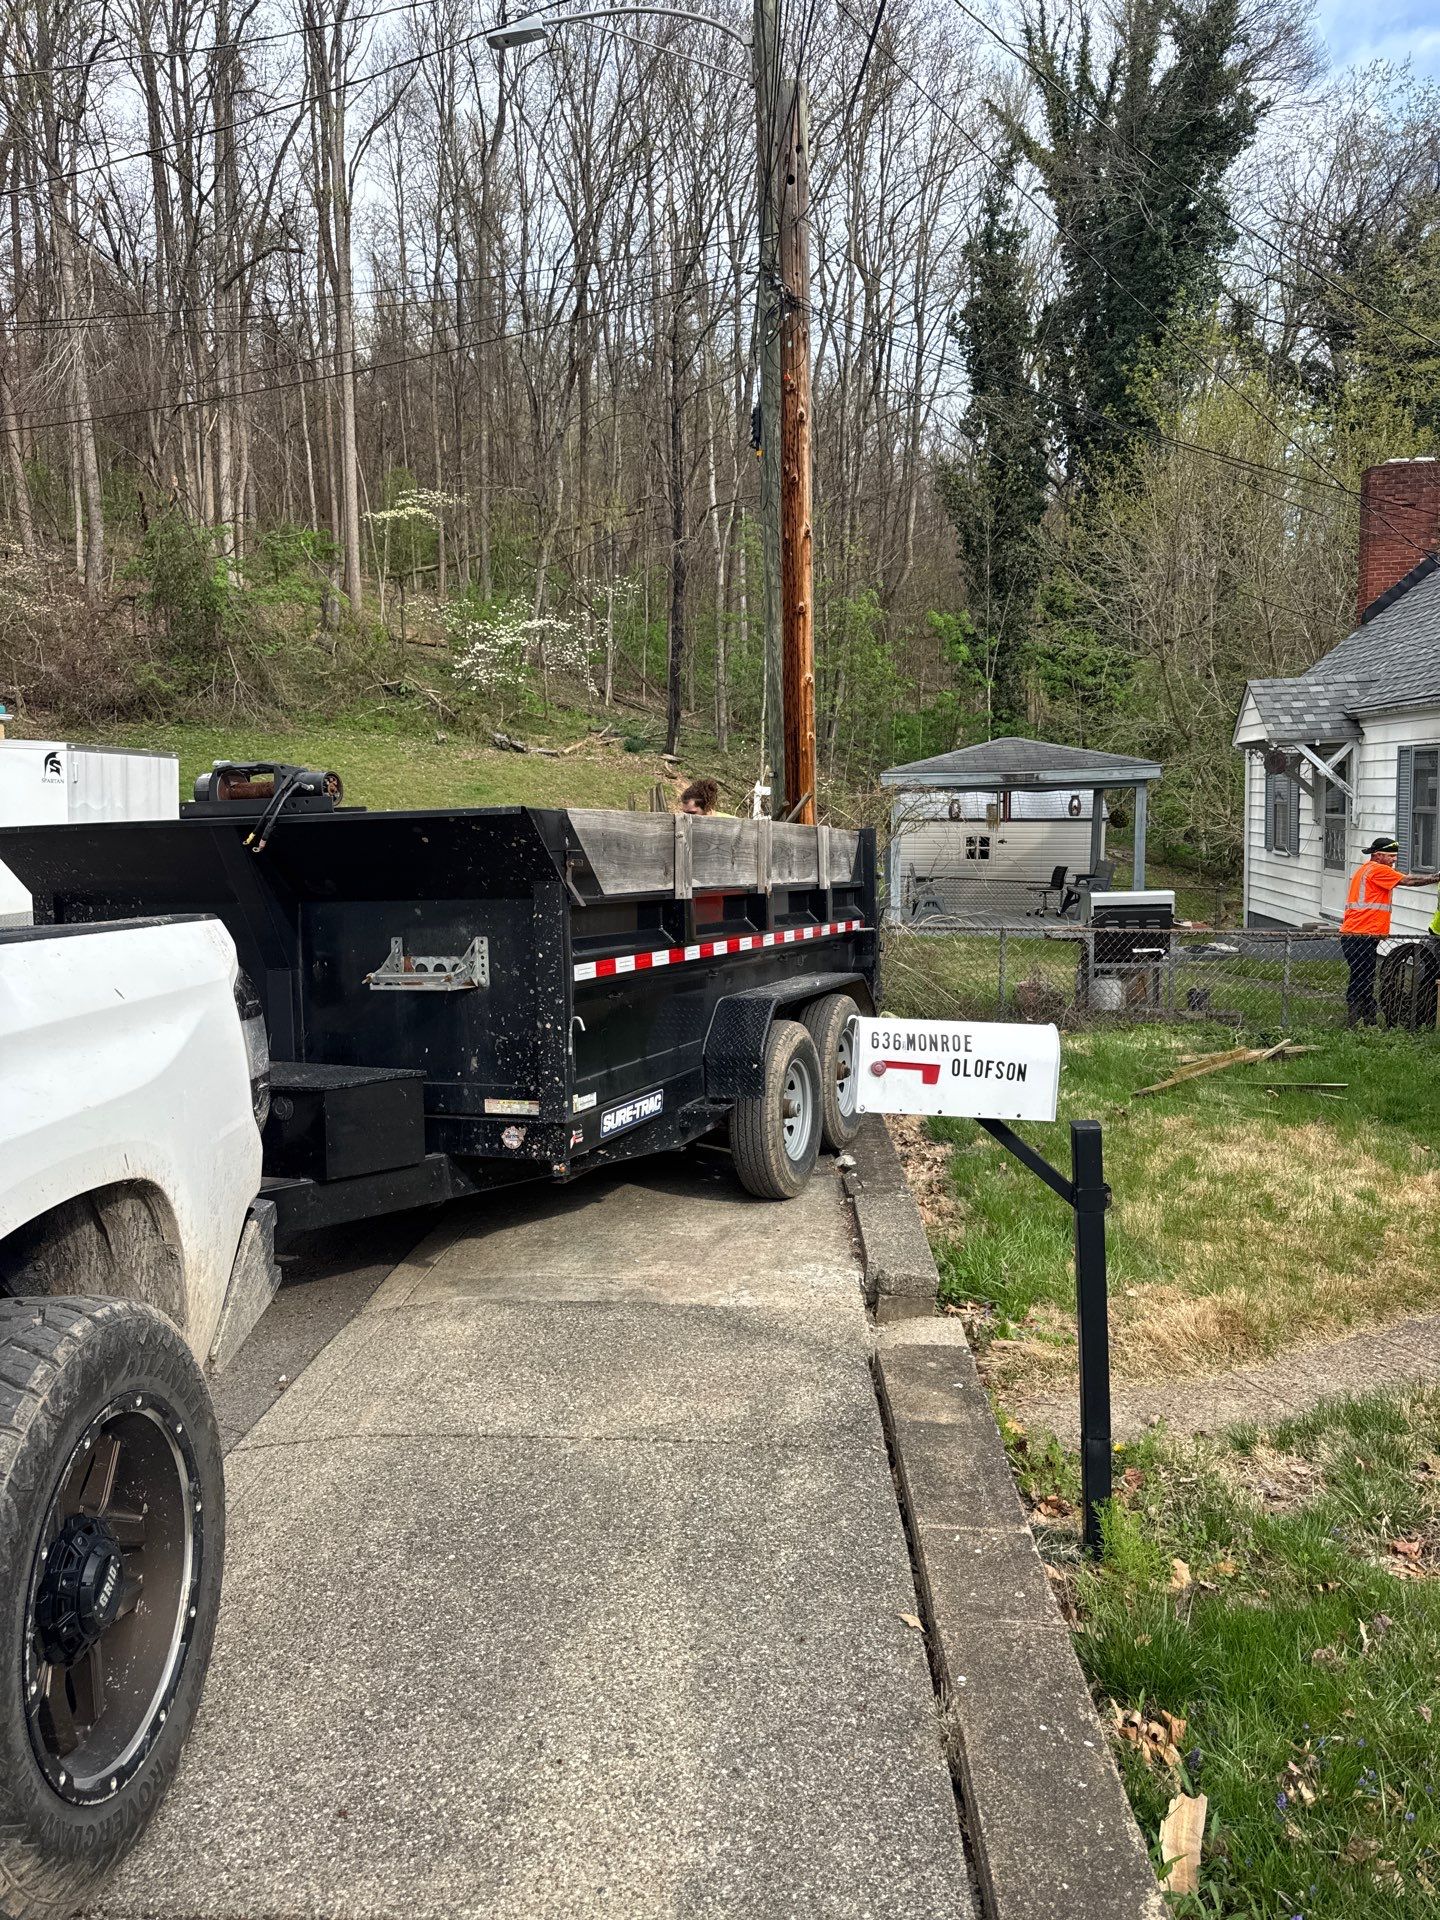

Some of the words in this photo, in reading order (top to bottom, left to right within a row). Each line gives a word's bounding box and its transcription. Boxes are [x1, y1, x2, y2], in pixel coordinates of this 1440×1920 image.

[871, 1031, 902, 1050] 636
[906, 1033, 973, 1053] MONROE
[951, 1058, 1028, 1082] OLOFSON
[603, 1093, 662, 1133] SURE-TRAC
